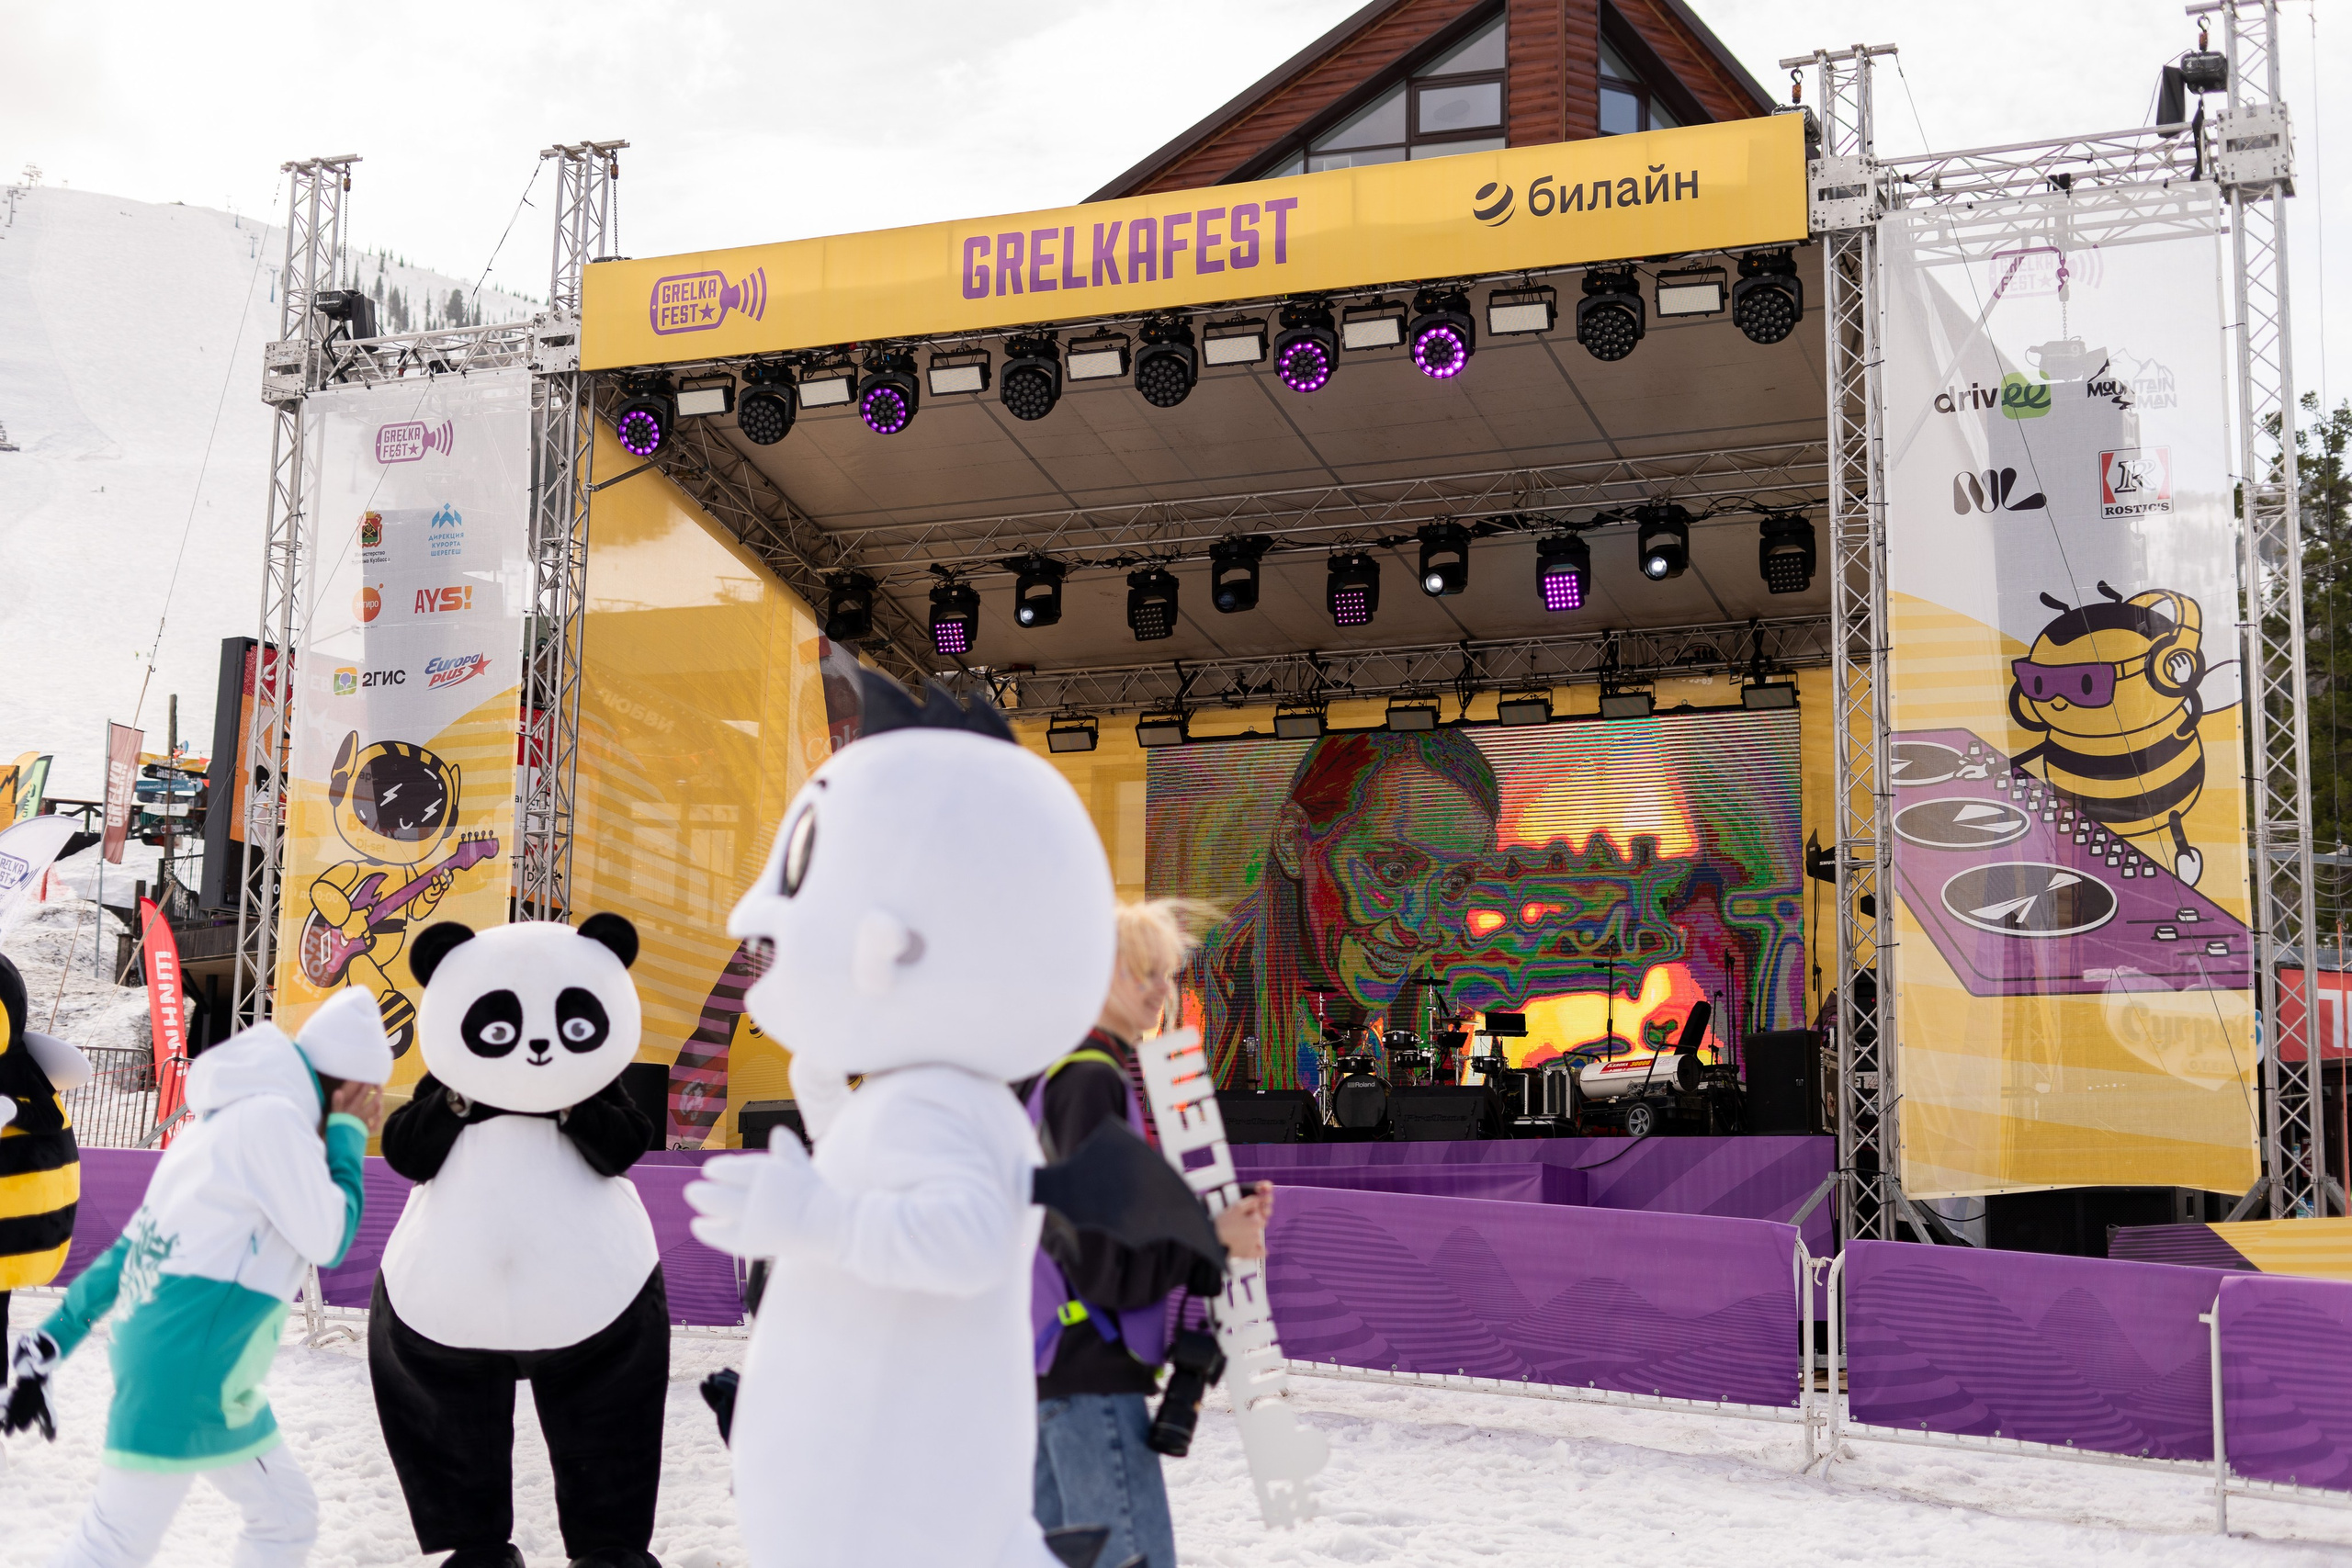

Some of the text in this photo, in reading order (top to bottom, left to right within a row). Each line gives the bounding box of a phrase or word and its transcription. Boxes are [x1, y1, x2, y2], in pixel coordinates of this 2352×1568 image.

[1528, 164, 1699, 217] билайн
[962, 197, 1298, 300] GRELKAFEST
[2000, 254, 2054, 274] GRELKA
[662, 278, 717, 304] GRELKA
[2000, 274, 2037, 292] FEST
[662, 303, 699, 326] FEST
[1934, 382, 2052, 414] drivee
[383, 427, 421, 443] GRELKA
[383, 444, 409, 457] FEST
[2105, 502, 2170, 515] ROSTIC'S
[428, 532, 464, 542] ДИРЕКЦИЯ
[431, 540, 461, 548] КУРОРТА
[430, 548, 461, 557] ШЕРЕГЕШ
[414, 586, 473, 614] AYS!
[362, 670, 406, 686] 2ГИС
[107, 761, 124, 828] GRELKA
[0, 857, 25, 875] RELKA
